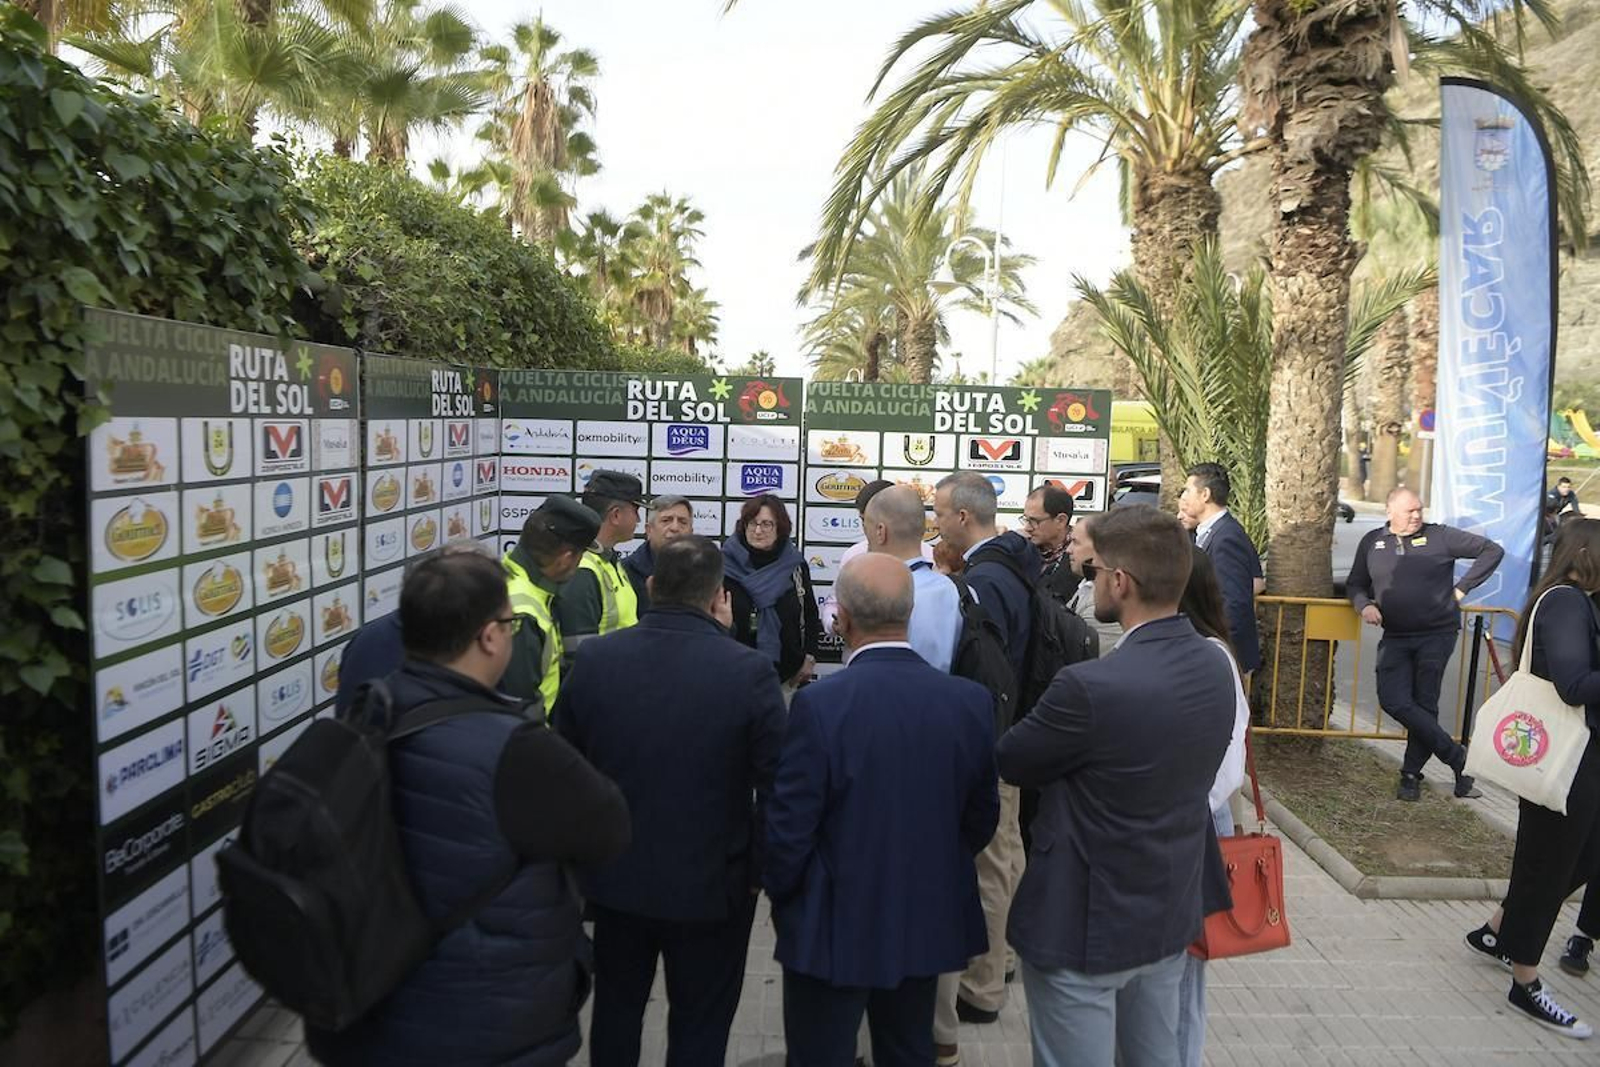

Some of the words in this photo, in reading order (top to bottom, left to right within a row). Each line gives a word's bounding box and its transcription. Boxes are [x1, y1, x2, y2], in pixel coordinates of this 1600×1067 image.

[229, 344, 289, 381] RUTA
[431, 369, 462, 393] RUTA
[499, 371, 568, 386] VUELTA
[230, 380, 272, 414] DEL
[276, 383, 314, 415] SOL
[500, 388, 511, 401] A
[516, 385, 624, 405] ANDALUCÍA
[627, 380, 698, 401] RUTA
[807, 382, 875, 397] VUELTA
[431, 393, 454, 417] DEL
[455, 394, 476, 417] SOL
[627, 401, 674, 420] DEL
[681, 402, 731, 422] SOL
[806, 399, 818, 414] A
[822, 399, 931, 416] ANDALUCÍA
[935, 391, 1006, 413] RUTA
[670, 427, 707, 438] AQUA
[934, 412, 982, 433] DEL
[988, 413, 1039, 435] SOL
[672, 436, 704, 446] DEUS
[503, 466, 569, 476] HONDA
[745, 467, 780, 477] AQUA
[746, 476, 778, 485] DEUS
[195, 725, 249, 770] SIGMA
